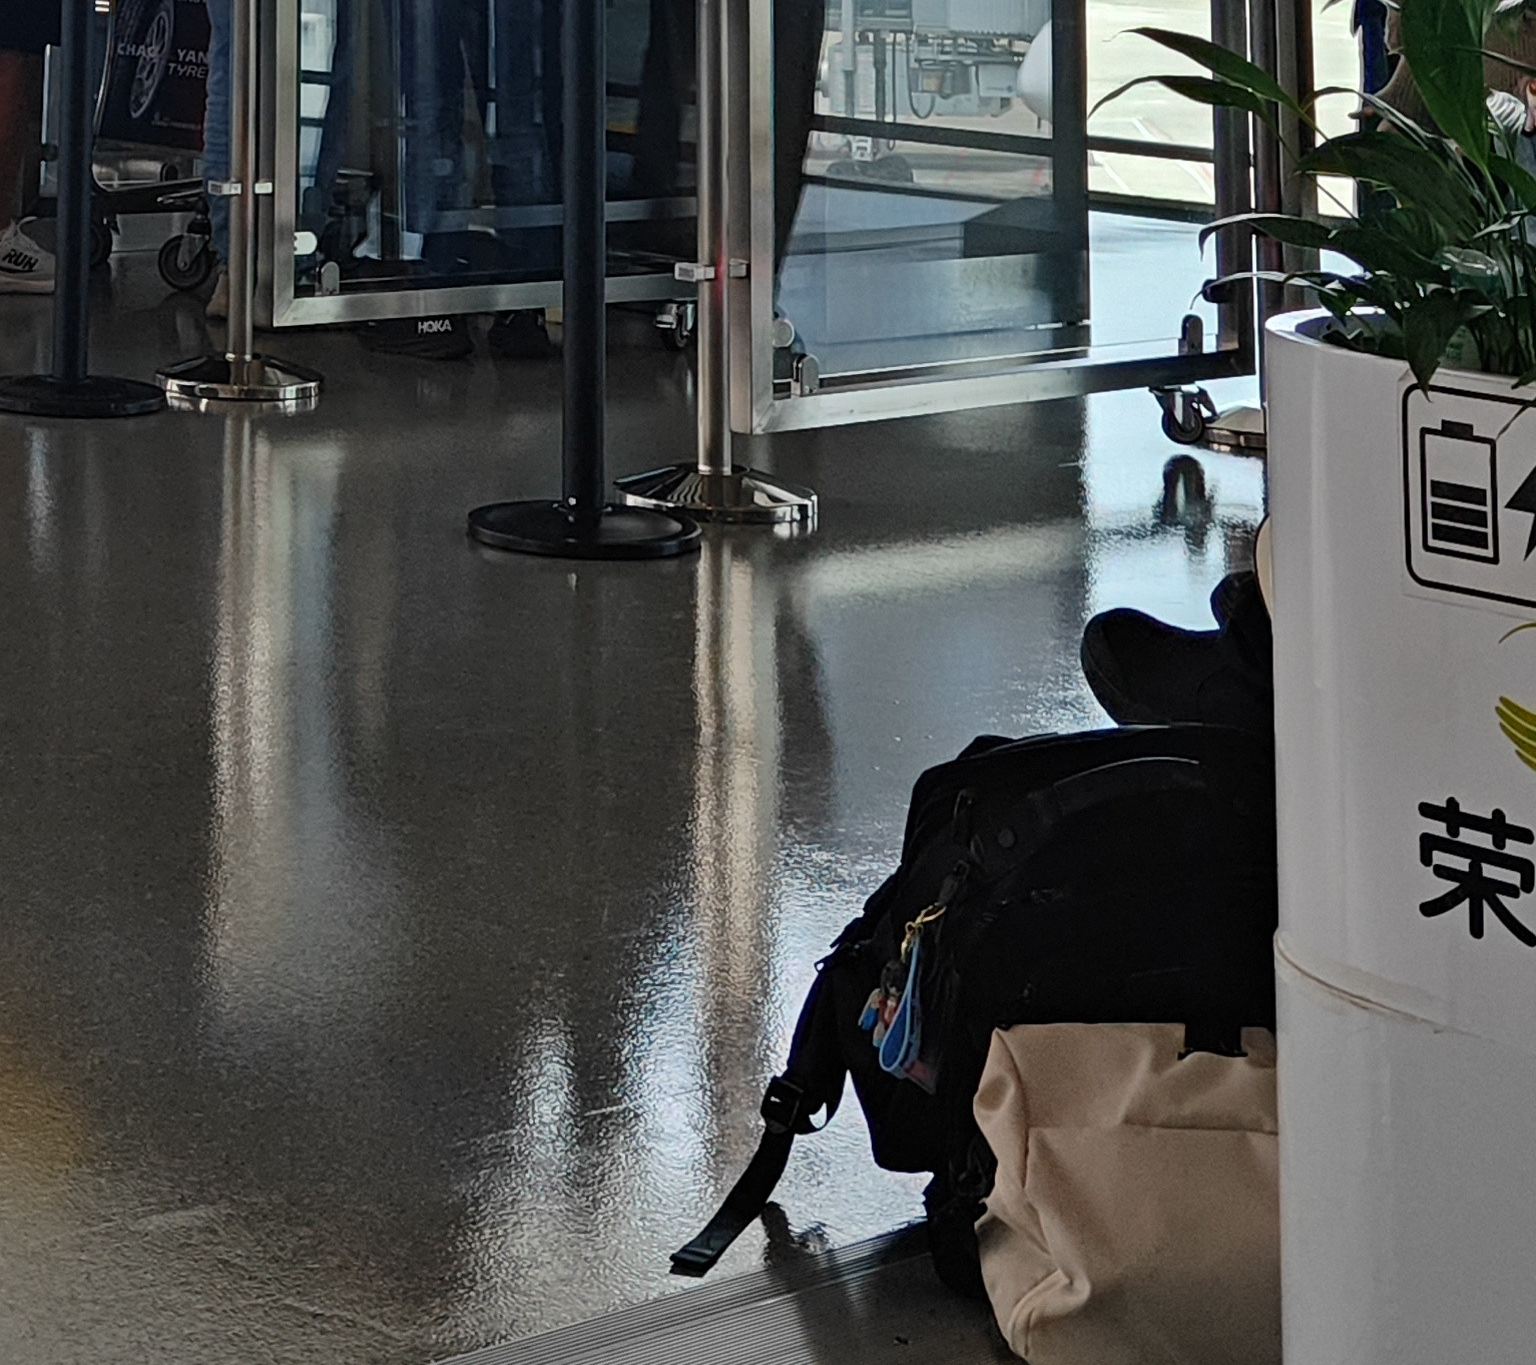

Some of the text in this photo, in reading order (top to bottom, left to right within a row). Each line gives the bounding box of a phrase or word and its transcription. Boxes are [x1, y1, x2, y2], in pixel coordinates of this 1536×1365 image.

[177, 48, 207, 64] YAN
[2, 248, 39, 271] RUN
[417, 319, 452, 334] HOKA
[1418, 796, 1536, 948] 荣
